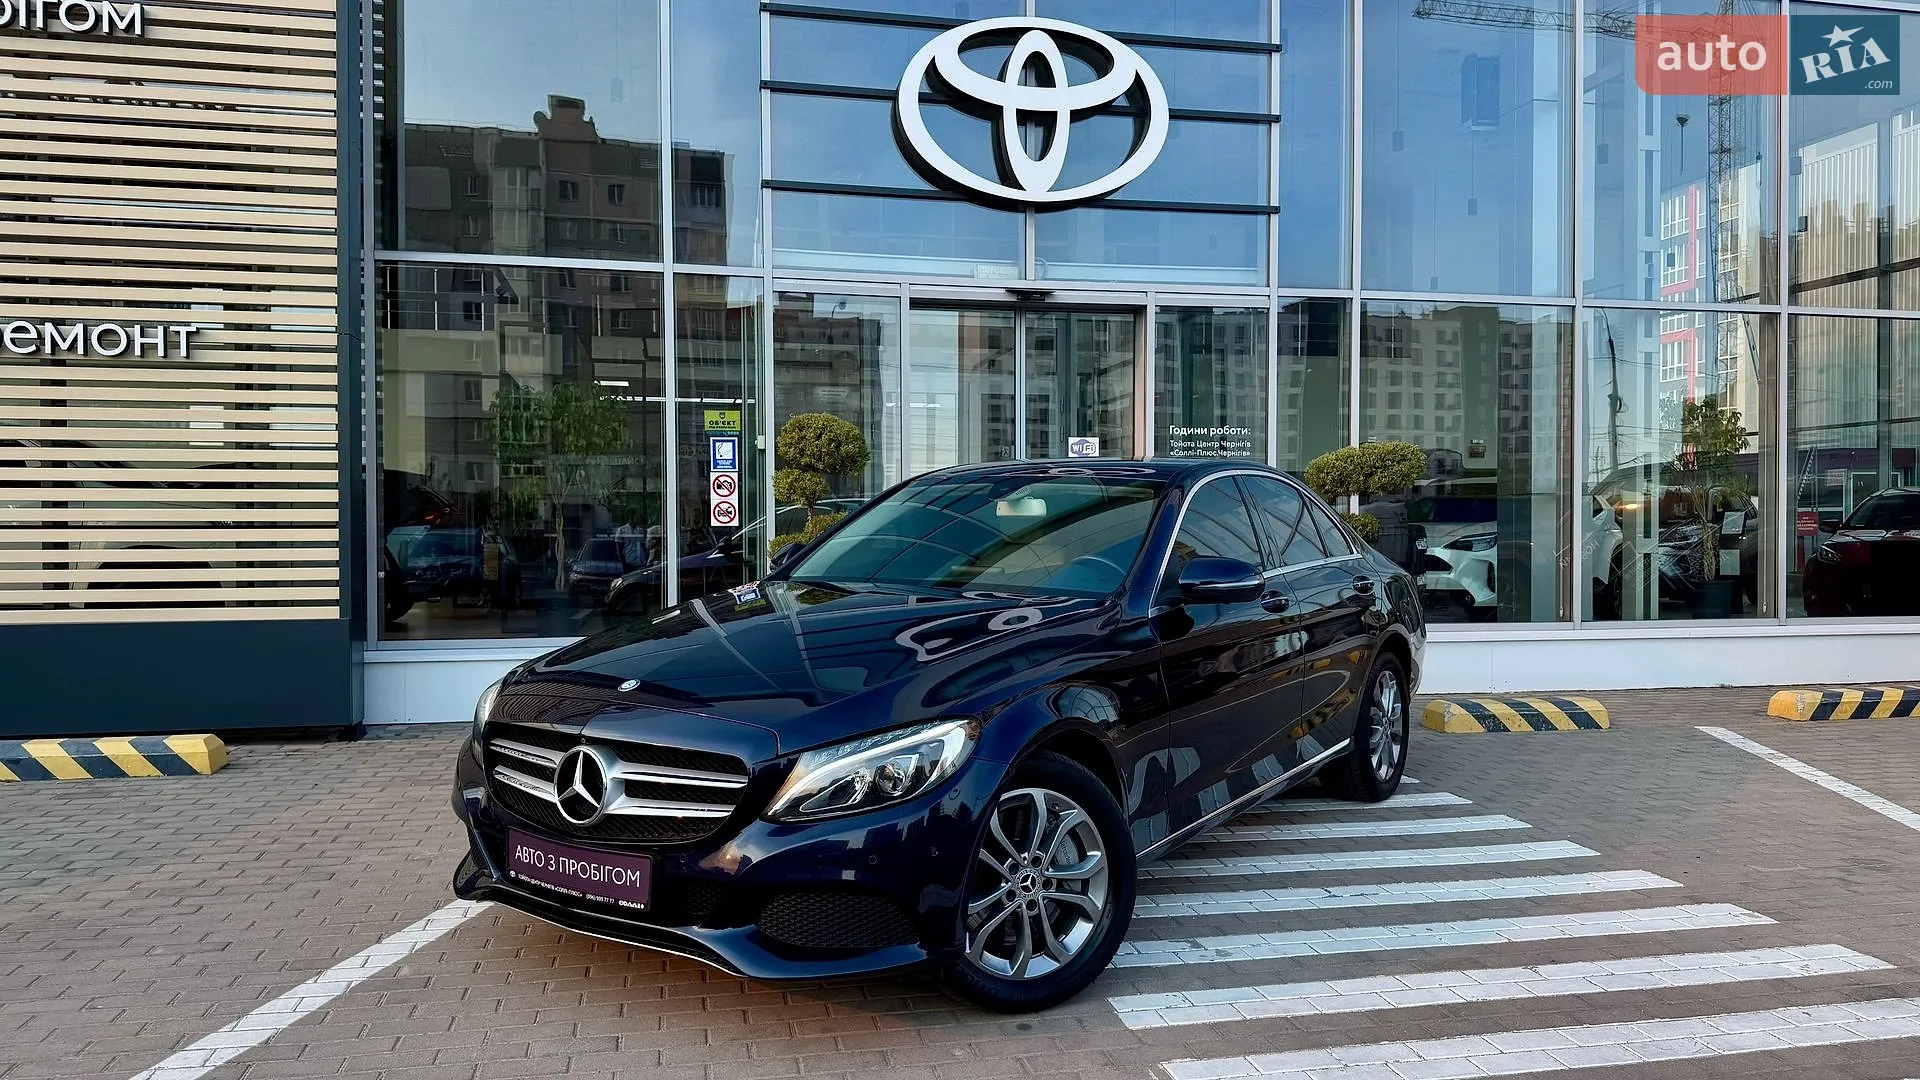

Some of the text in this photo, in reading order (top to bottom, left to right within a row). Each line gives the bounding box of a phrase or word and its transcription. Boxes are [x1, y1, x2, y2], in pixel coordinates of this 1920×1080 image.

[0, 320, 197, 357] емонт
[1169, 425, 1252, 437] Години роботи:
[1169, 439, 1252, 449] Тойота Центр Чернігів
[515, 845, 545, 868] АВТО
[559, 857, 640, 888] ПРОБІГОМ
